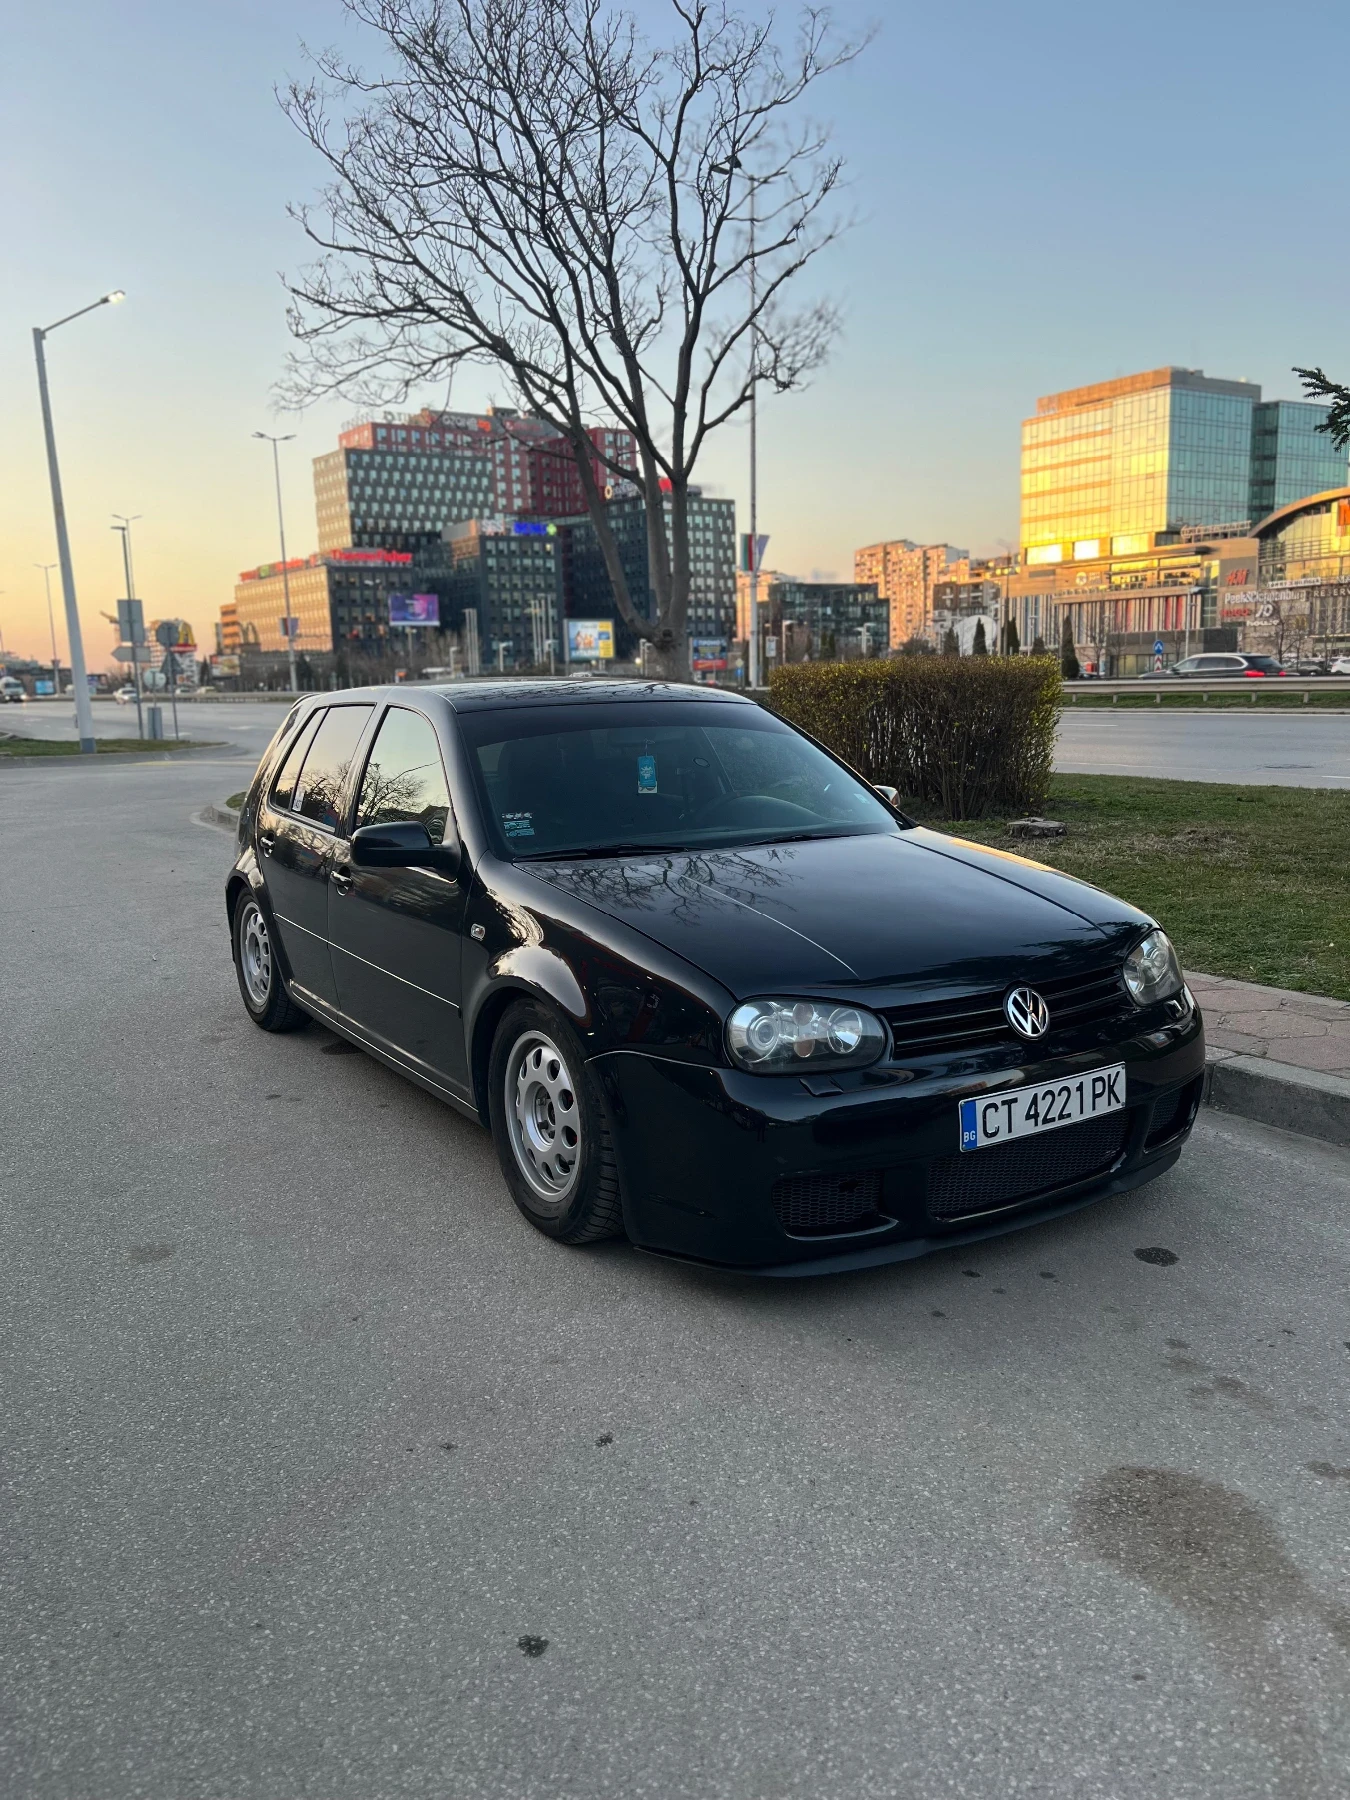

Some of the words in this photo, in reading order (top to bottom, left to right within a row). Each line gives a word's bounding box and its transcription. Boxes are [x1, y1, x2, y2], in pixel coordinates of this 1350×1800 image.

[982, 1097, 1018, 1139] CT
[1025, 1081, 1084, 1127] 4221
[1092, 1070, 1121, 1111] PK
[963, 1131, 976, 1143] BG
